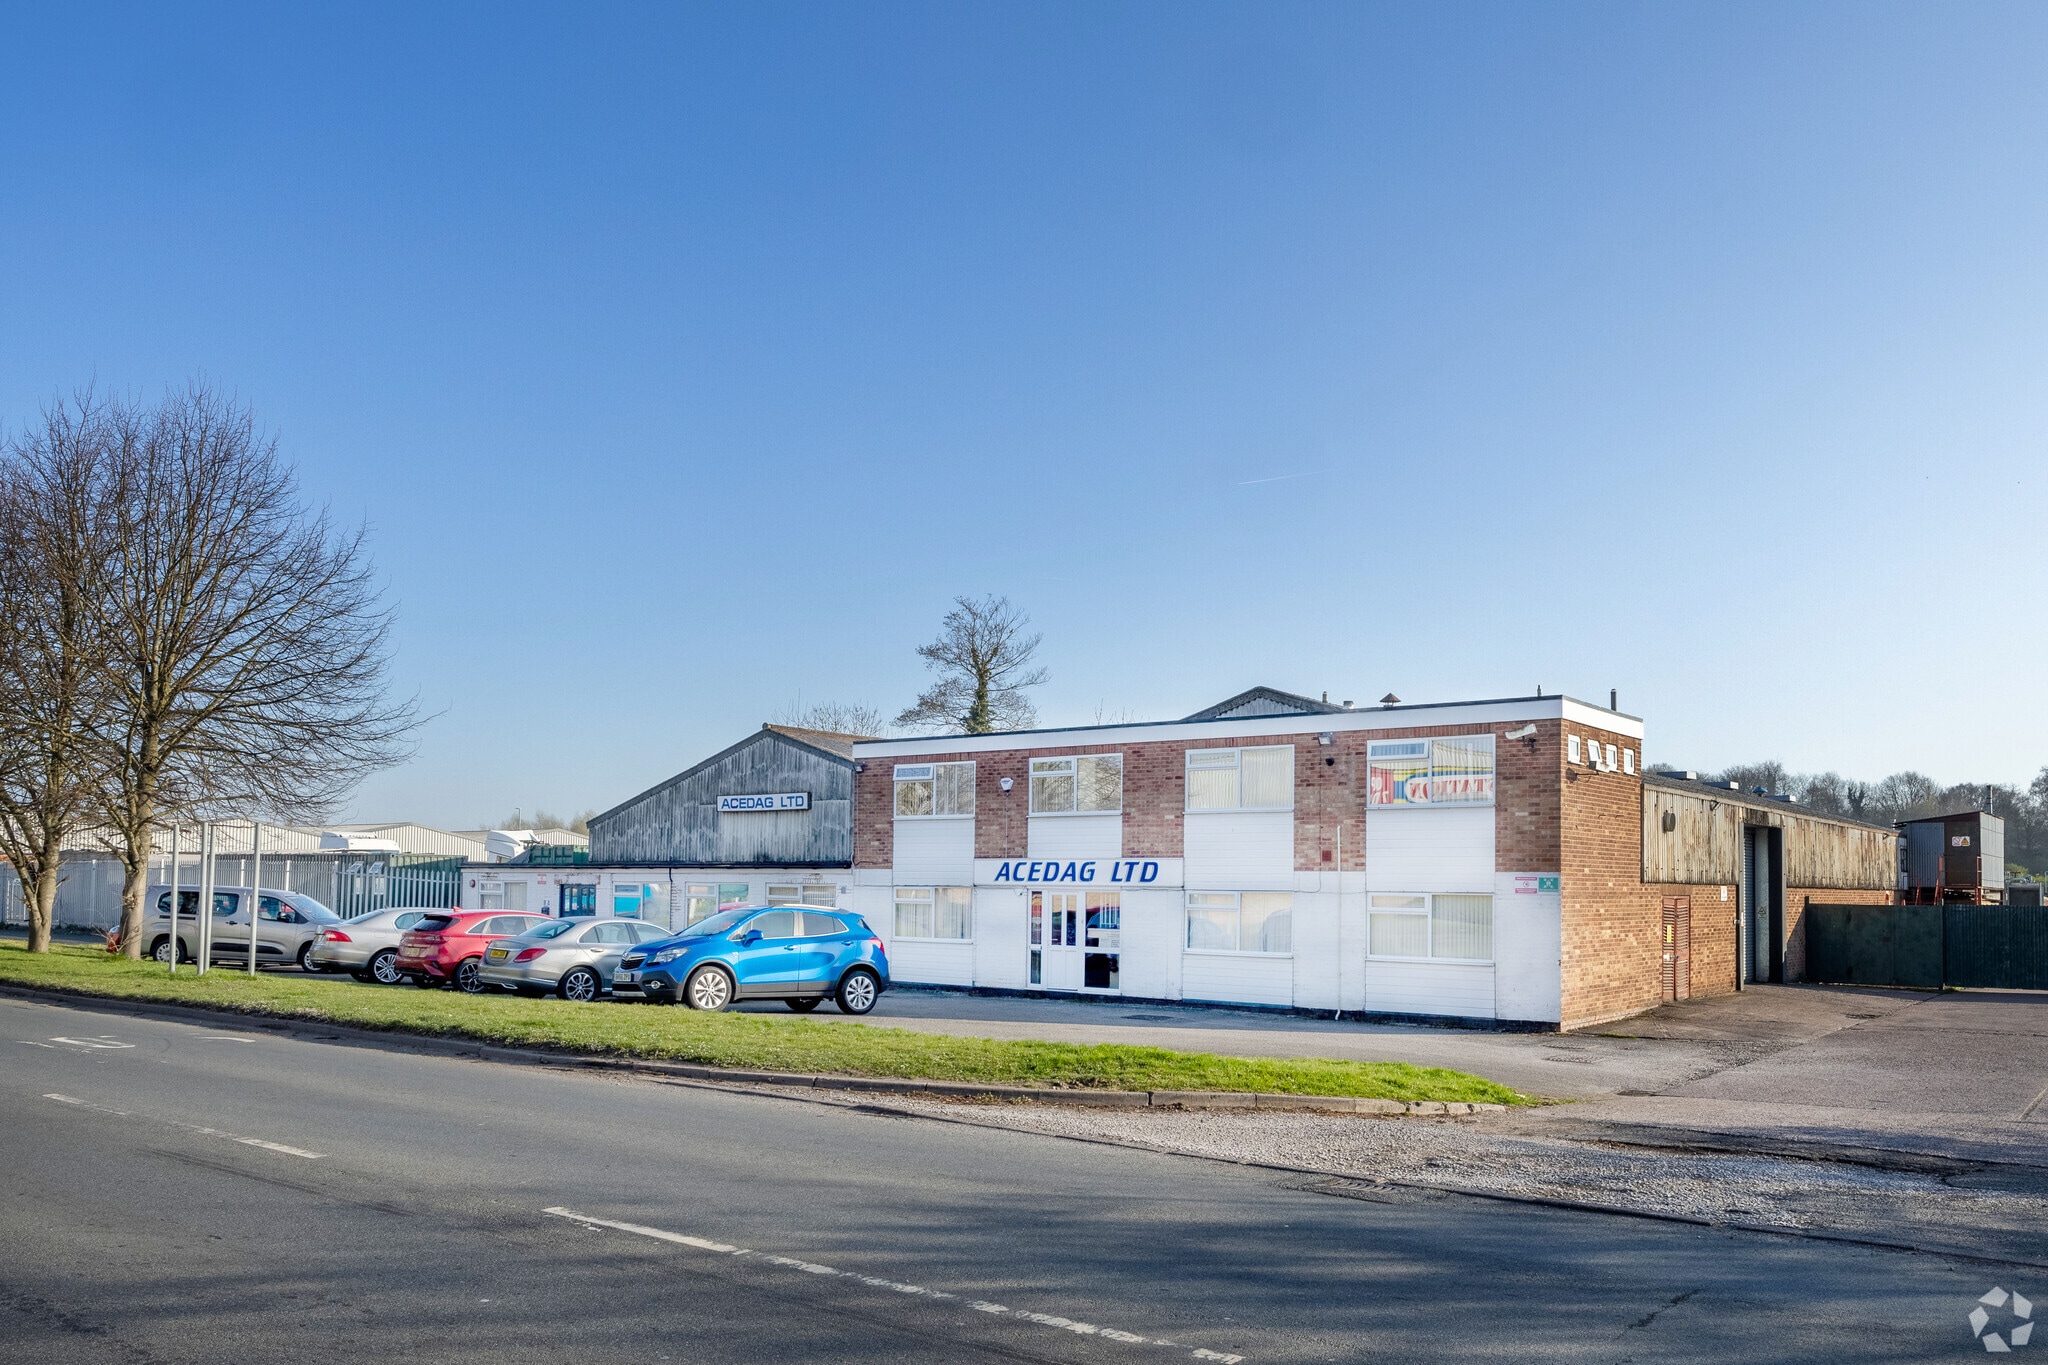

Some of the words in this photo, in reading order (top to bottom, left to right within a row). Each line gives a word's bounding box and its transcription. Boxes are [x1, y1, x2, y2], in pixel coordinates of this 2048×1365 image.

[721, 797, 774, 809] ACEDAG
[780, 795, 804, 807] LTD
[994, 861, 1096, 882] ACEDAG
[1111, 861, 1159, 882] LTD
